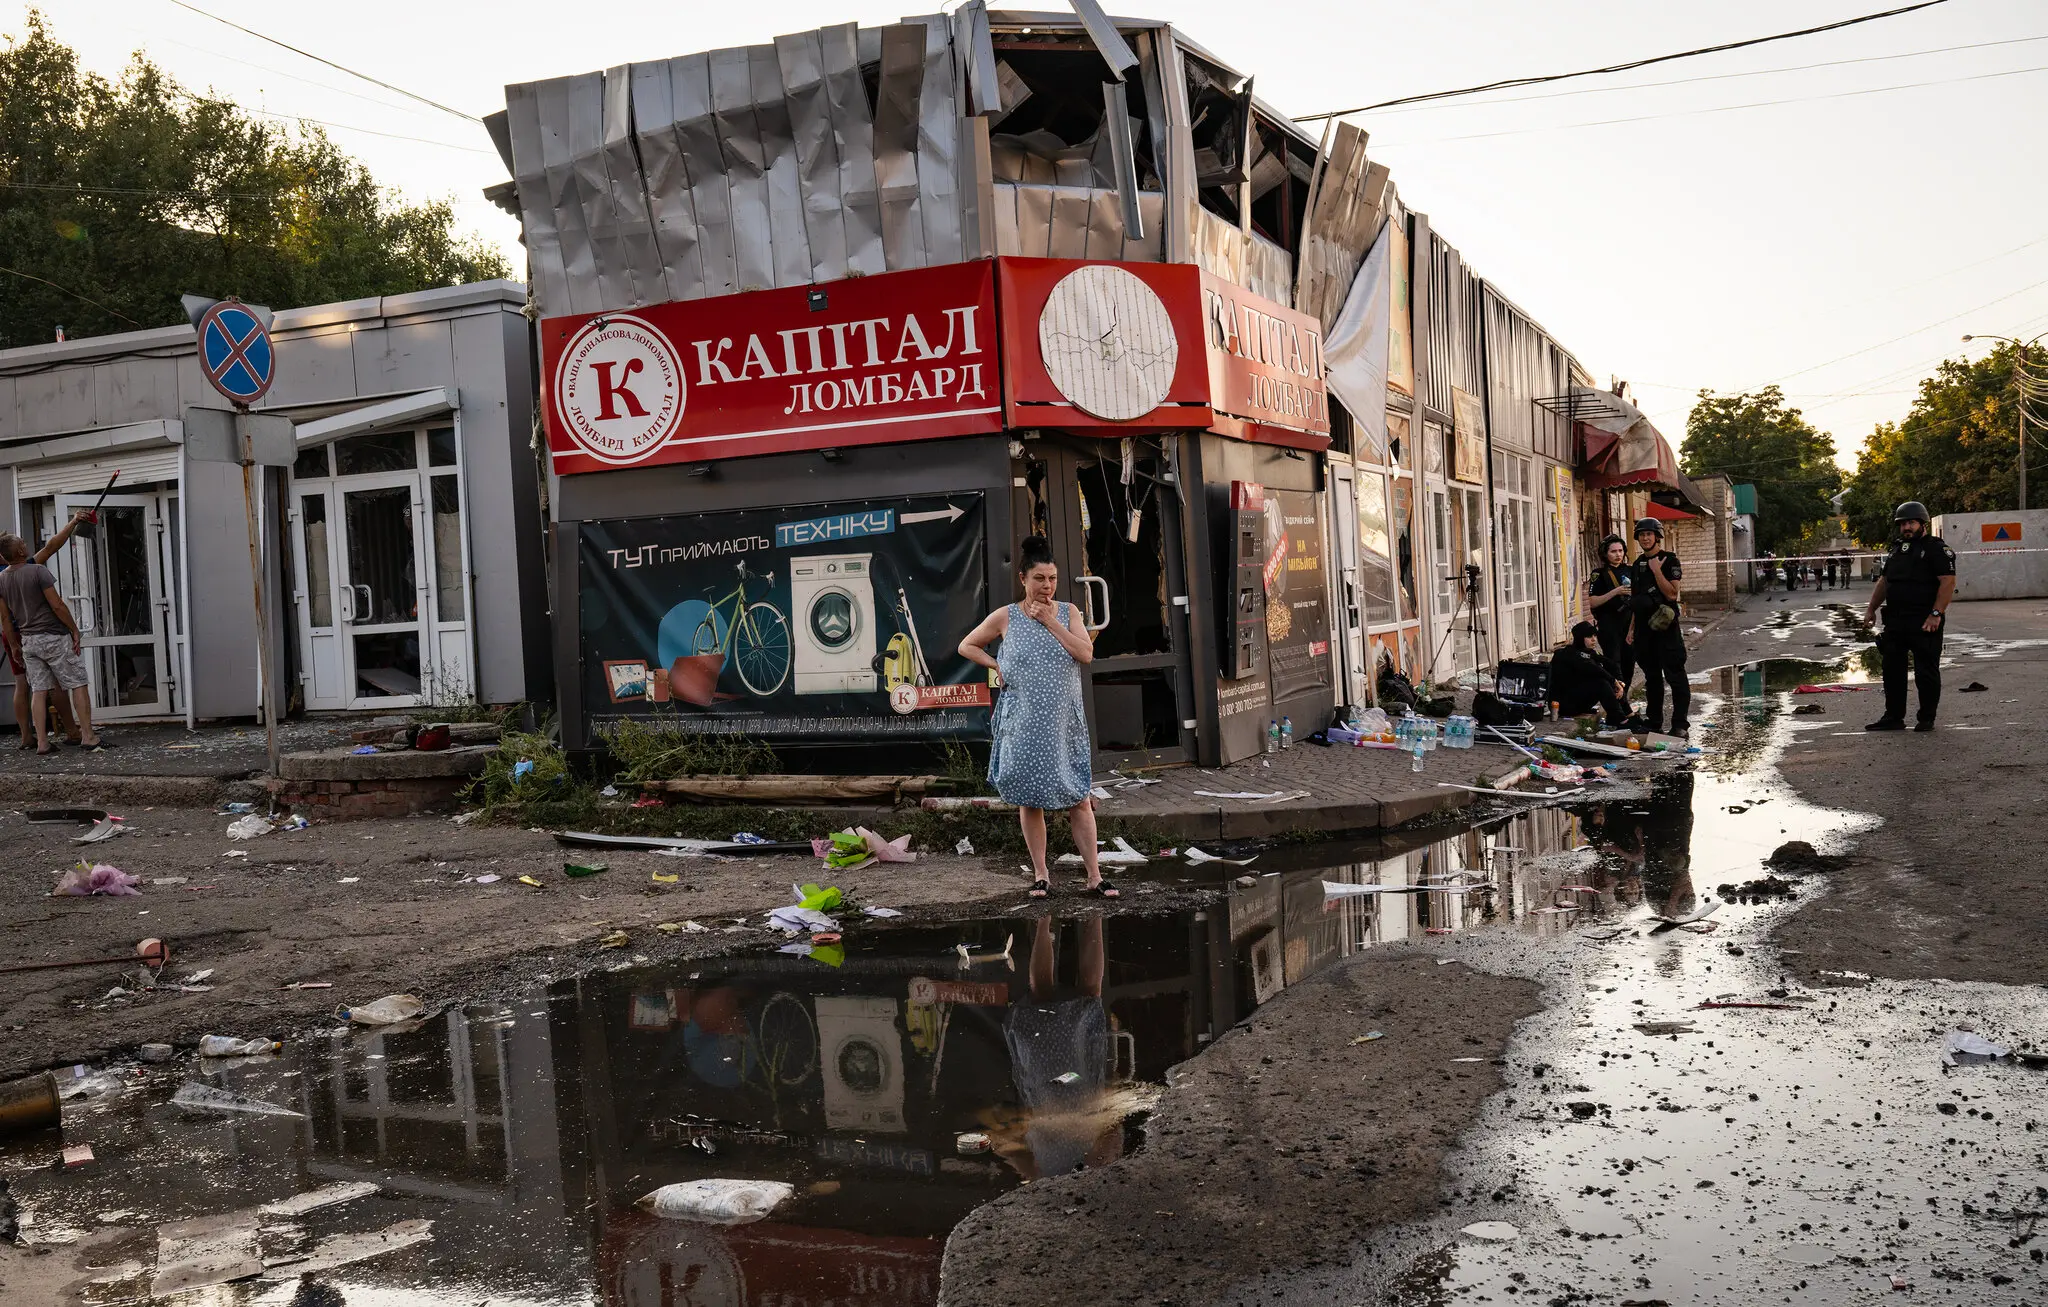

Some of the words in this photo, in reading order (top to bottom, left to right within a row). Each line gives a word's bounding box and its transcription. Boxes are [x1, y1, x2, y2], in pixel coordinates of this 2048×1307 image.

[568, 358, 583, 391] ВАША
[580, 330, 631, 358] ФІНАНСОВА
[632, 333, 672, 381] ДОПОМОГА
[691, 305, 982, 386] КАПІТАЛ
[1205, 289, 1322, 380] КАПІТАЛ
[589, 358, 650, 421] К
[784, 363, 985, 415] ЛОМБАРД
[1247, 373, 1326, 429] ЛОМБАРД
[571, 406, 624, 450] ЛОМБАРД
[632, 394, 673, 447] КАПІТАЛ
[607, 545, 659, 569] ТУТ
[660, 535, 770, 563] ПРИЙМАЮТЬ
[1297, 540, 1306, 552] НА
[921, 685, 977, 698] КАПІТАЛ
[935, 695, 978, 705] ЛОМБАРД
[1243, 698, 1252, 711] 703
